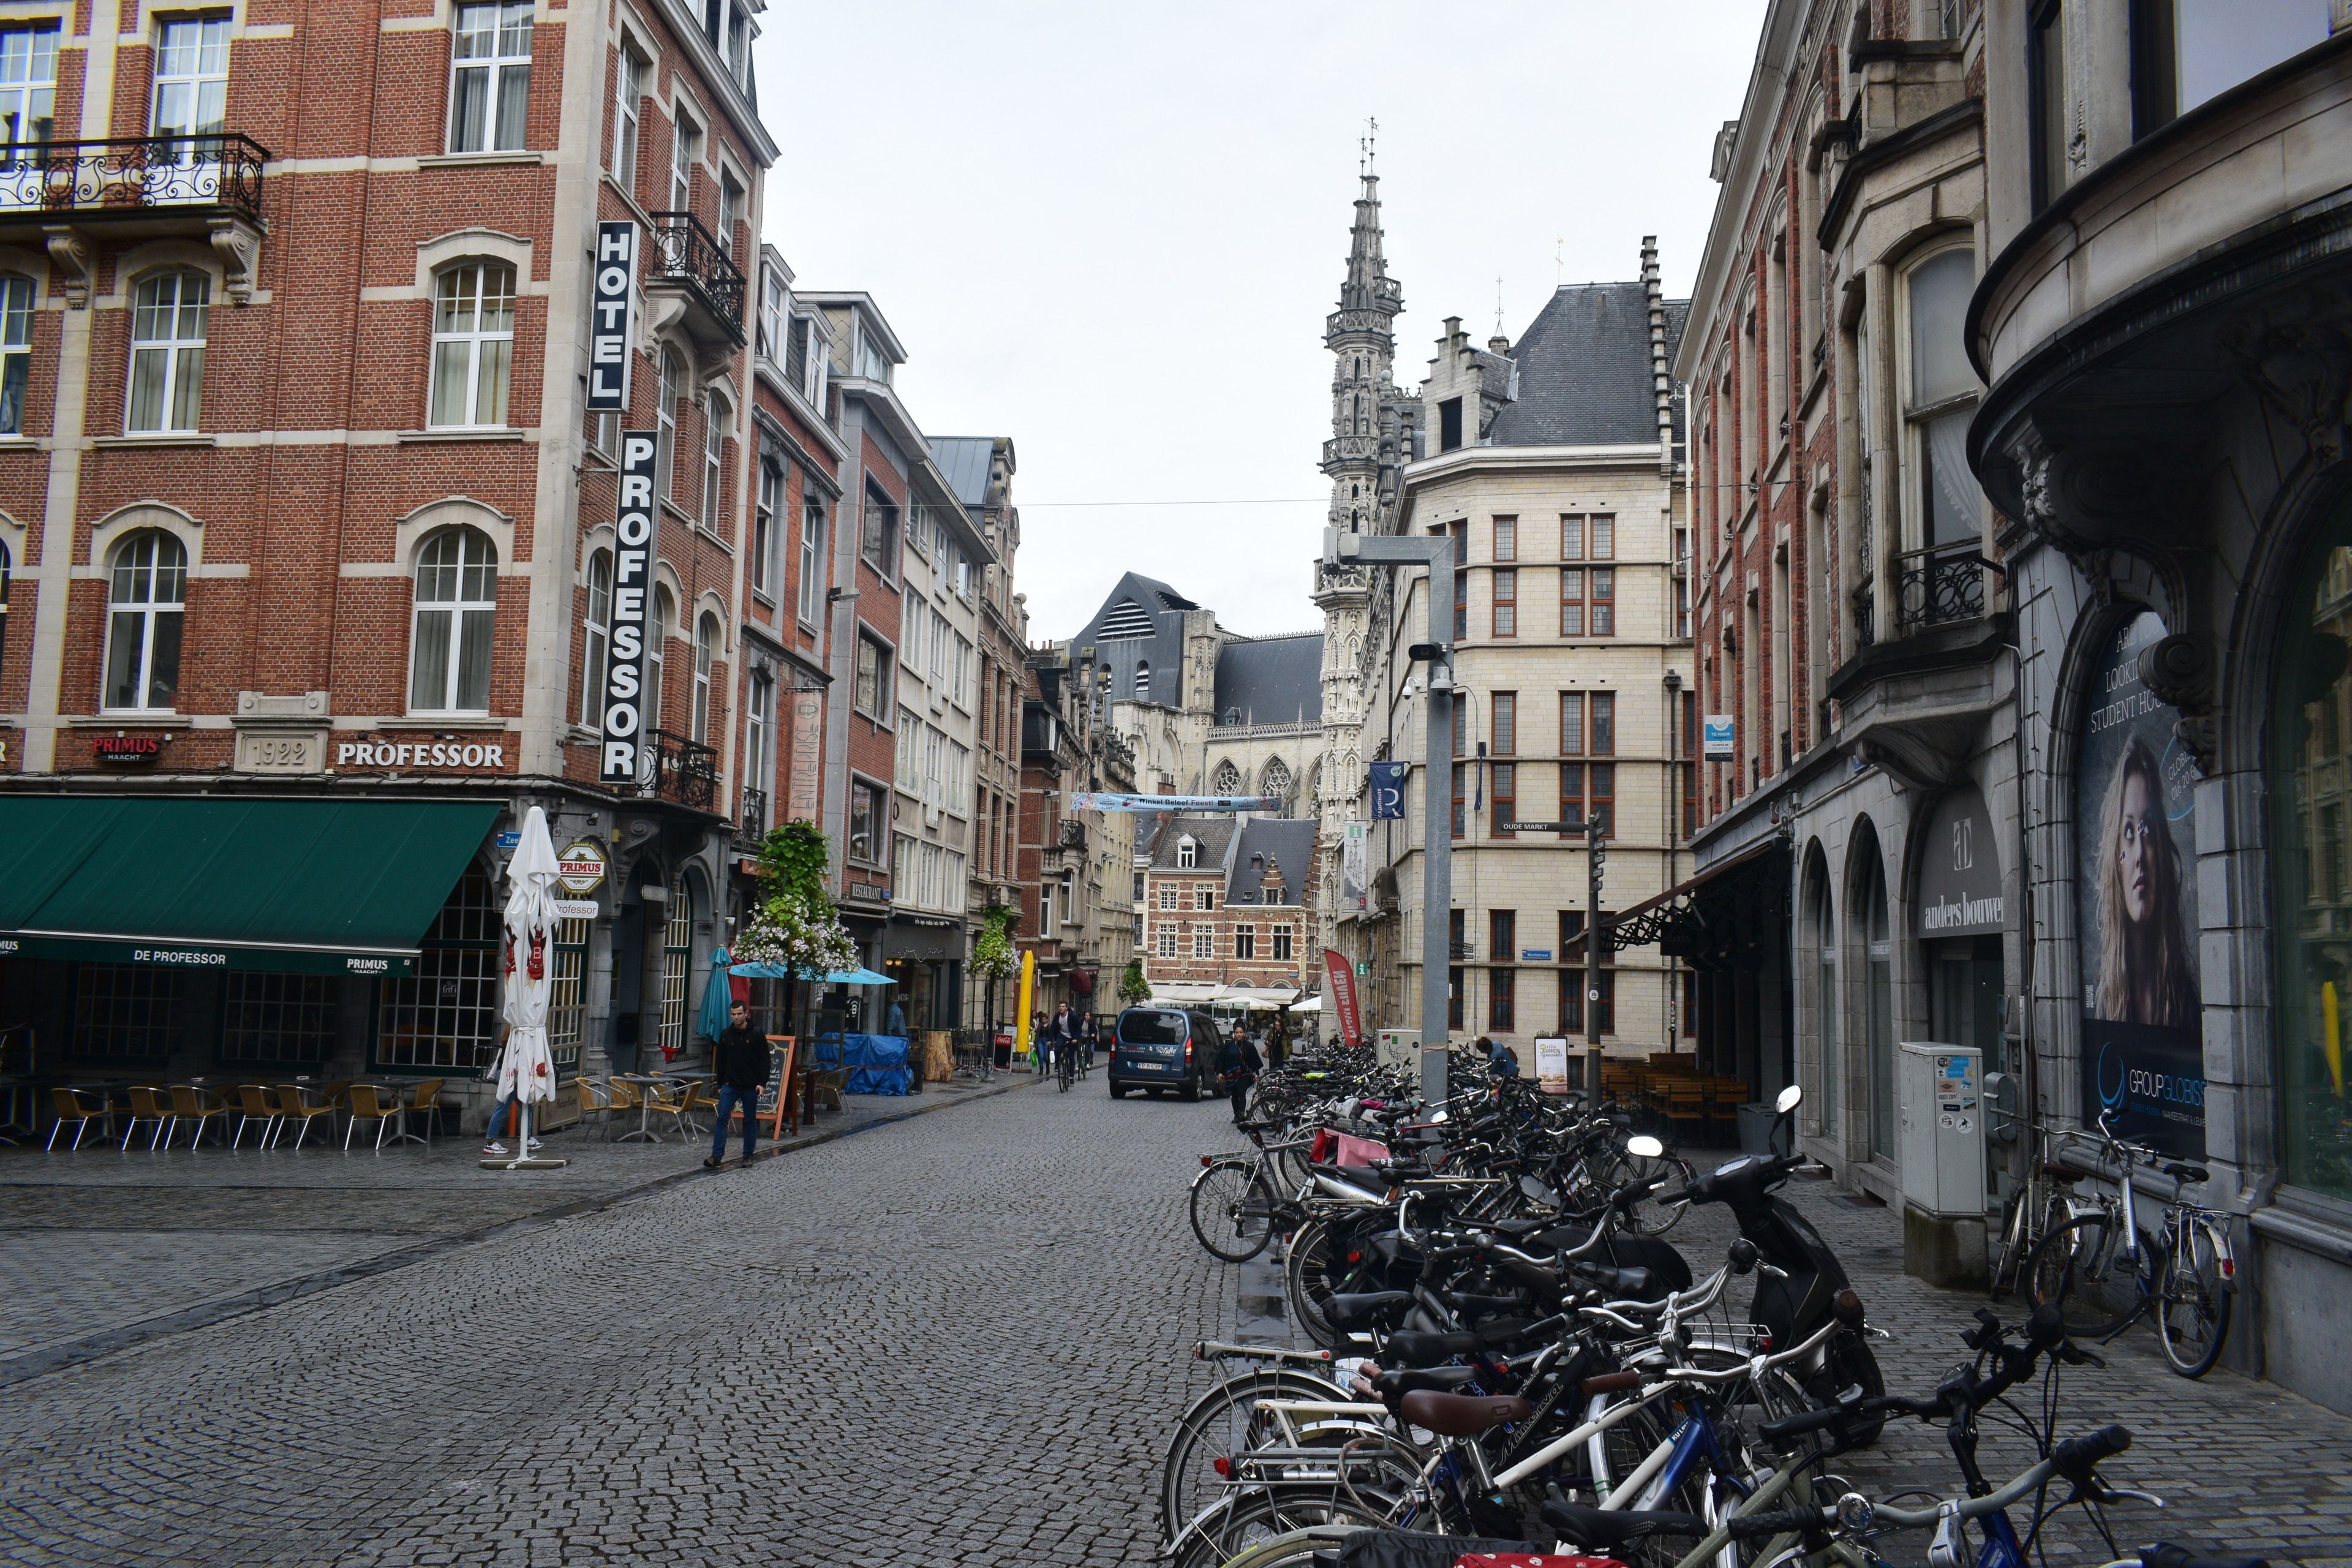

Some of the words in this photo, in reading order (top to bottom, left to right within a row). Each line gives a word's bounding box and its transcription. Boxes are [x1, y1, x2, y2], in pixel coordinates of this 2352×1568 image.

[592, 233, 630, 397] HOTEL
[604, 438, 654, 776] PROFESSOR
[2117, 624, 2135, 652] ARE
[2106, 658, 2138, 693] LOOKI
[2092, 696, 2136, 733] STUDENT
[93, 737, 158, 753] PRIMUS
[253, 741, 306, 765] 1922
[337, 743, 504, 767] PROFESSOR
[791, 724, 818, 810] ENTREPRISE
[560, 862, 601, 872] PRIMUS
[852, 883, 881, 901] RESTAURANT
[1925, 895, 1961, 930] anders
[134, 950, 151, 960] DE
[153, 951, 226, 965] PROFESSOR
[347, 959, 388, 970] PRIMUS
[1499, 1382, 1564, 1466] Minerva
[1671, 1431, 1681, 1441] KU
